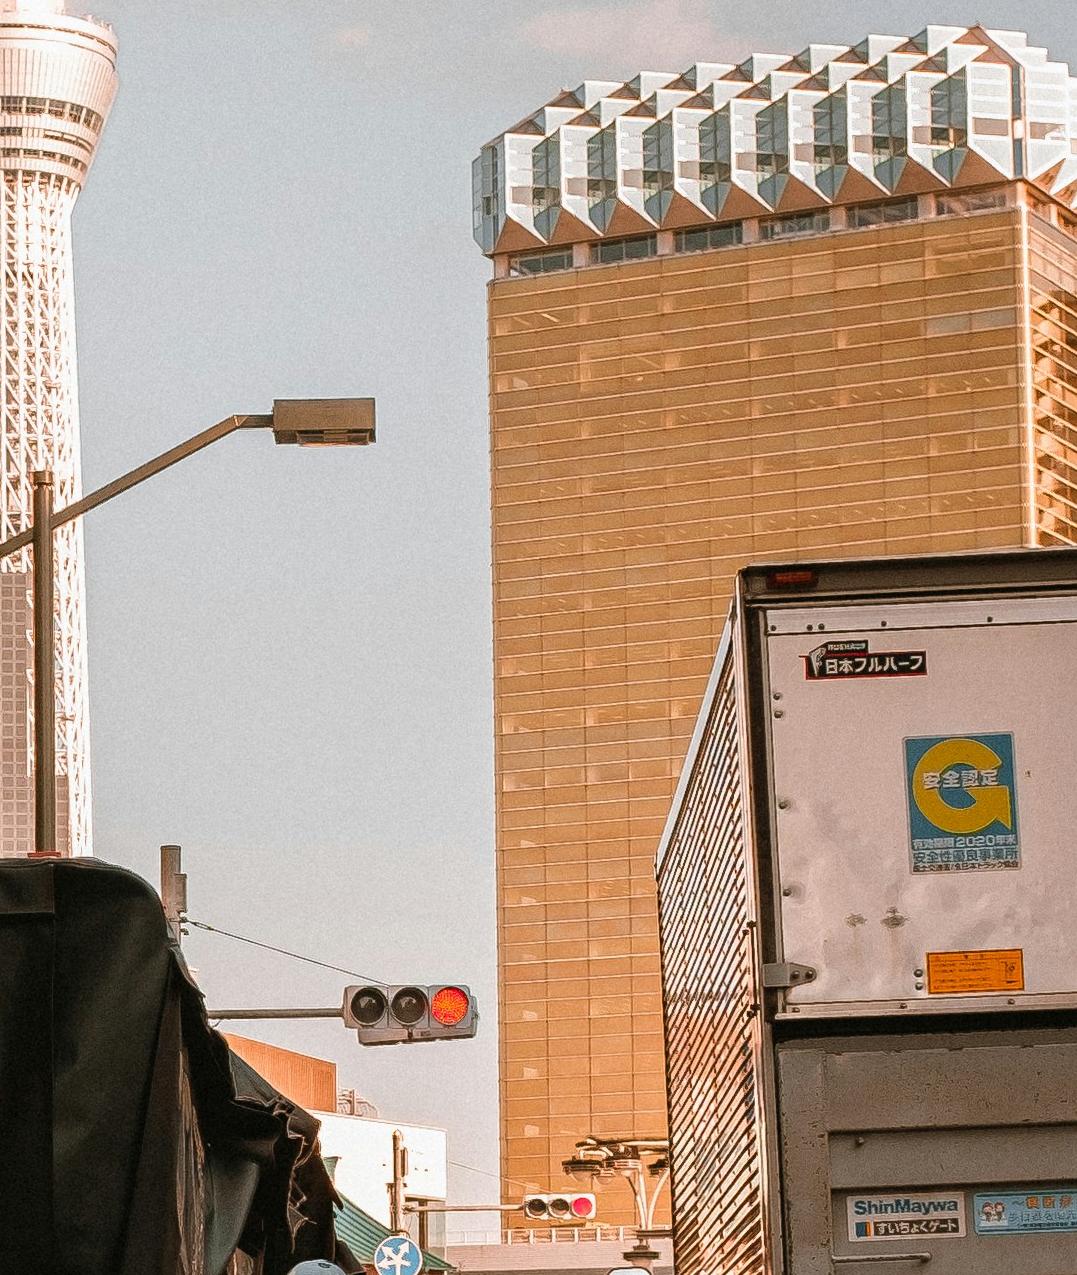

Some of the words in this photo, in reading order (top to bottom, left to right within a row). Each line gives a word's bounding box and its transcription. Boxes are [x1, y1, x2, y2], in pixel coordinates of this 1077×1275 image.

[825, 655, 923, 675] 日本フルハーフ
[854, 1198, 958, 1216] ShinMaywa
[876, 1219, 958, 1235] すいちょくゲート
